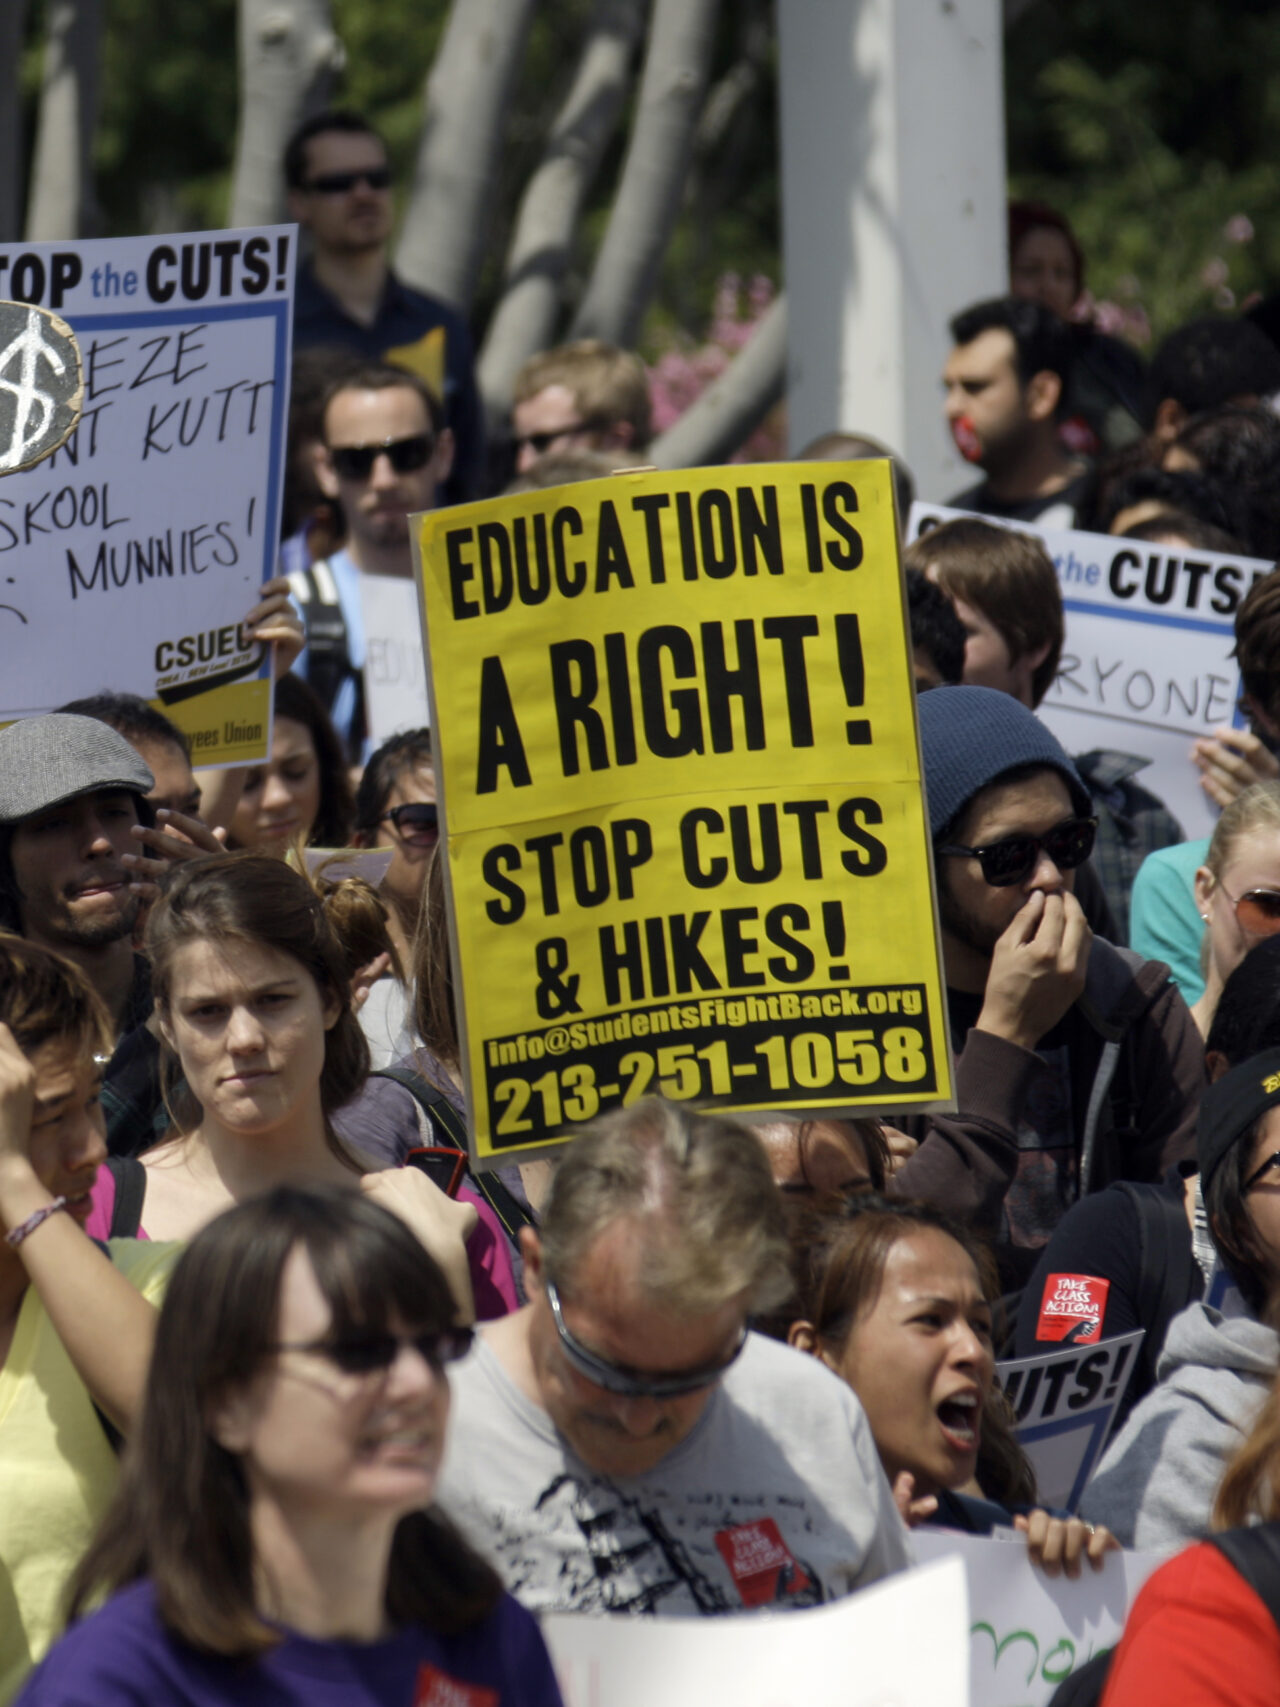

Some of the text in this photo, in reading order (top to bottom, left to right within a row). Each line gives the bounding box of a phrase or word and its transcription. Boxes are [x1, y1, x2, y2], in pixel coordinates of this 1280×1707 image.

[91, 262, 138, 298] the
[146, 236, 290, 304] CUTS!
[86, 324, 208, 401] EZE
[144, 378, 276, 460] KUTT
[446, 481, 864, 620] EDUCATION IS
[1055, 550, 1266, 615] the CUTS
[224, 719, 262, 745] Union
[476, 613, 873, 795] A RIGHT!
[482, 797, 888, 925] STOP CUTS
[534, 900, 851, 1020] & HIKES!
[488, 988, 923, 1068] info@StudentsFightBack.org
[494, 1026, 927, 1135] 213-251-1058
[1046, 1300, 1099, 1317] ACTION!
[1054, 1290, 1091, 1303] CLASS
[1057, 1278, 1091, 1291] TAKE
[1003, 1344, 1133, 1421] UTS!
